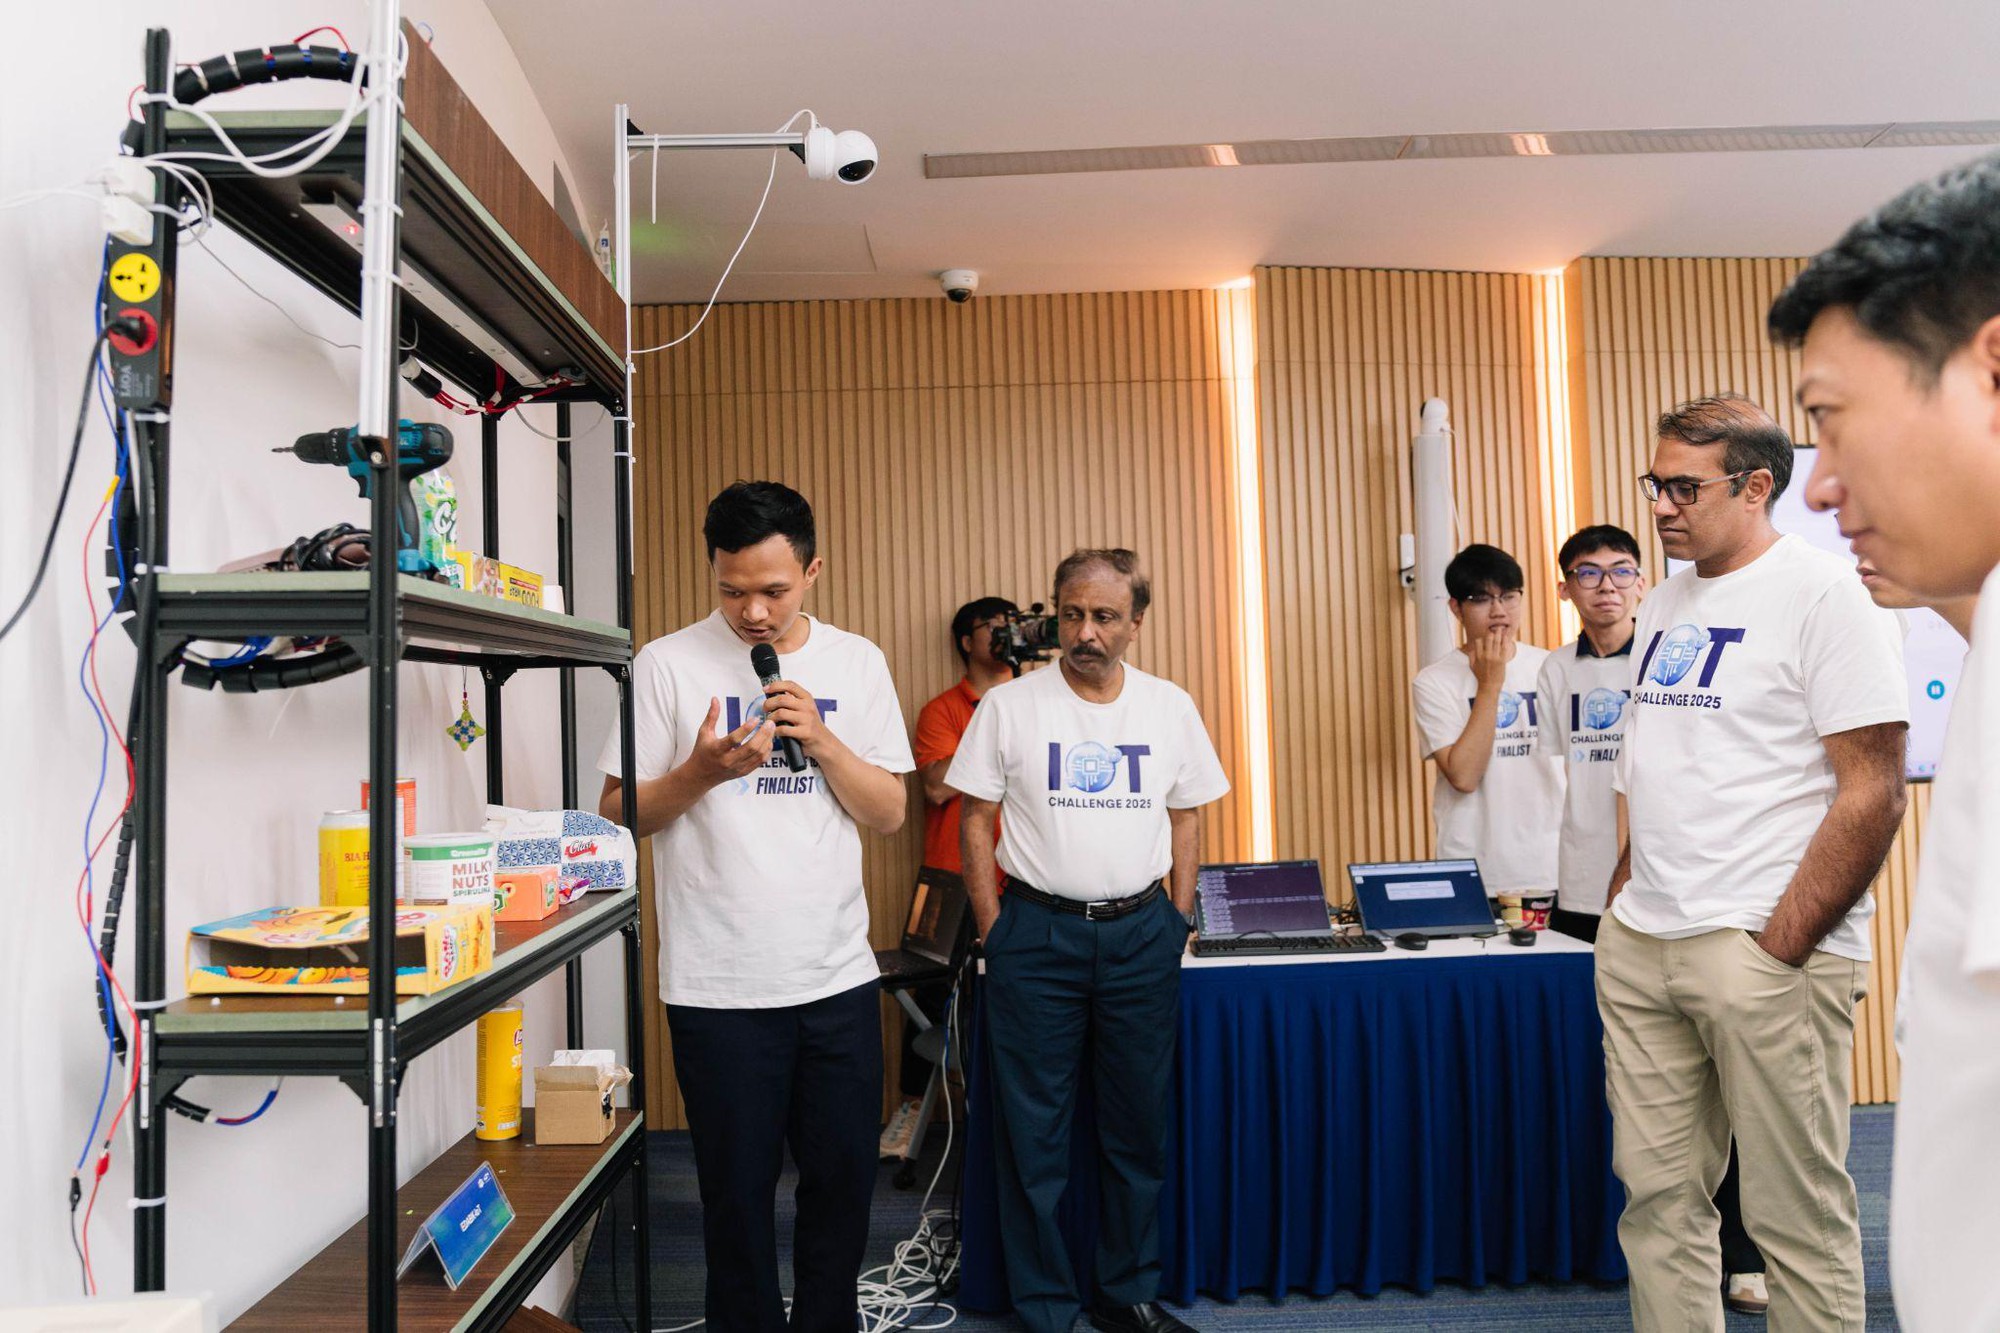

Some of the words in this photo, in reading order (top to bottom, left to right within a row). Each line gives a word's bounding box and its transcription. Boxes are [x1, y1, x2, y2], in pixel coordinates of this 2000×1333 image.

[1690, 695, 1722, 709] 2025
[1527, 730, 1539, 738] 20
[1496, 744, 1531, 758] FINALIST
[1048, 741, 1151, 793] IOT
[756, 776, 815, 795] FINALIST
[1048, 796, 1122, 808] CHALLENGE
[1125, 799, 1152, 809] 2025
[452, 874, 489, 890] NUTS
